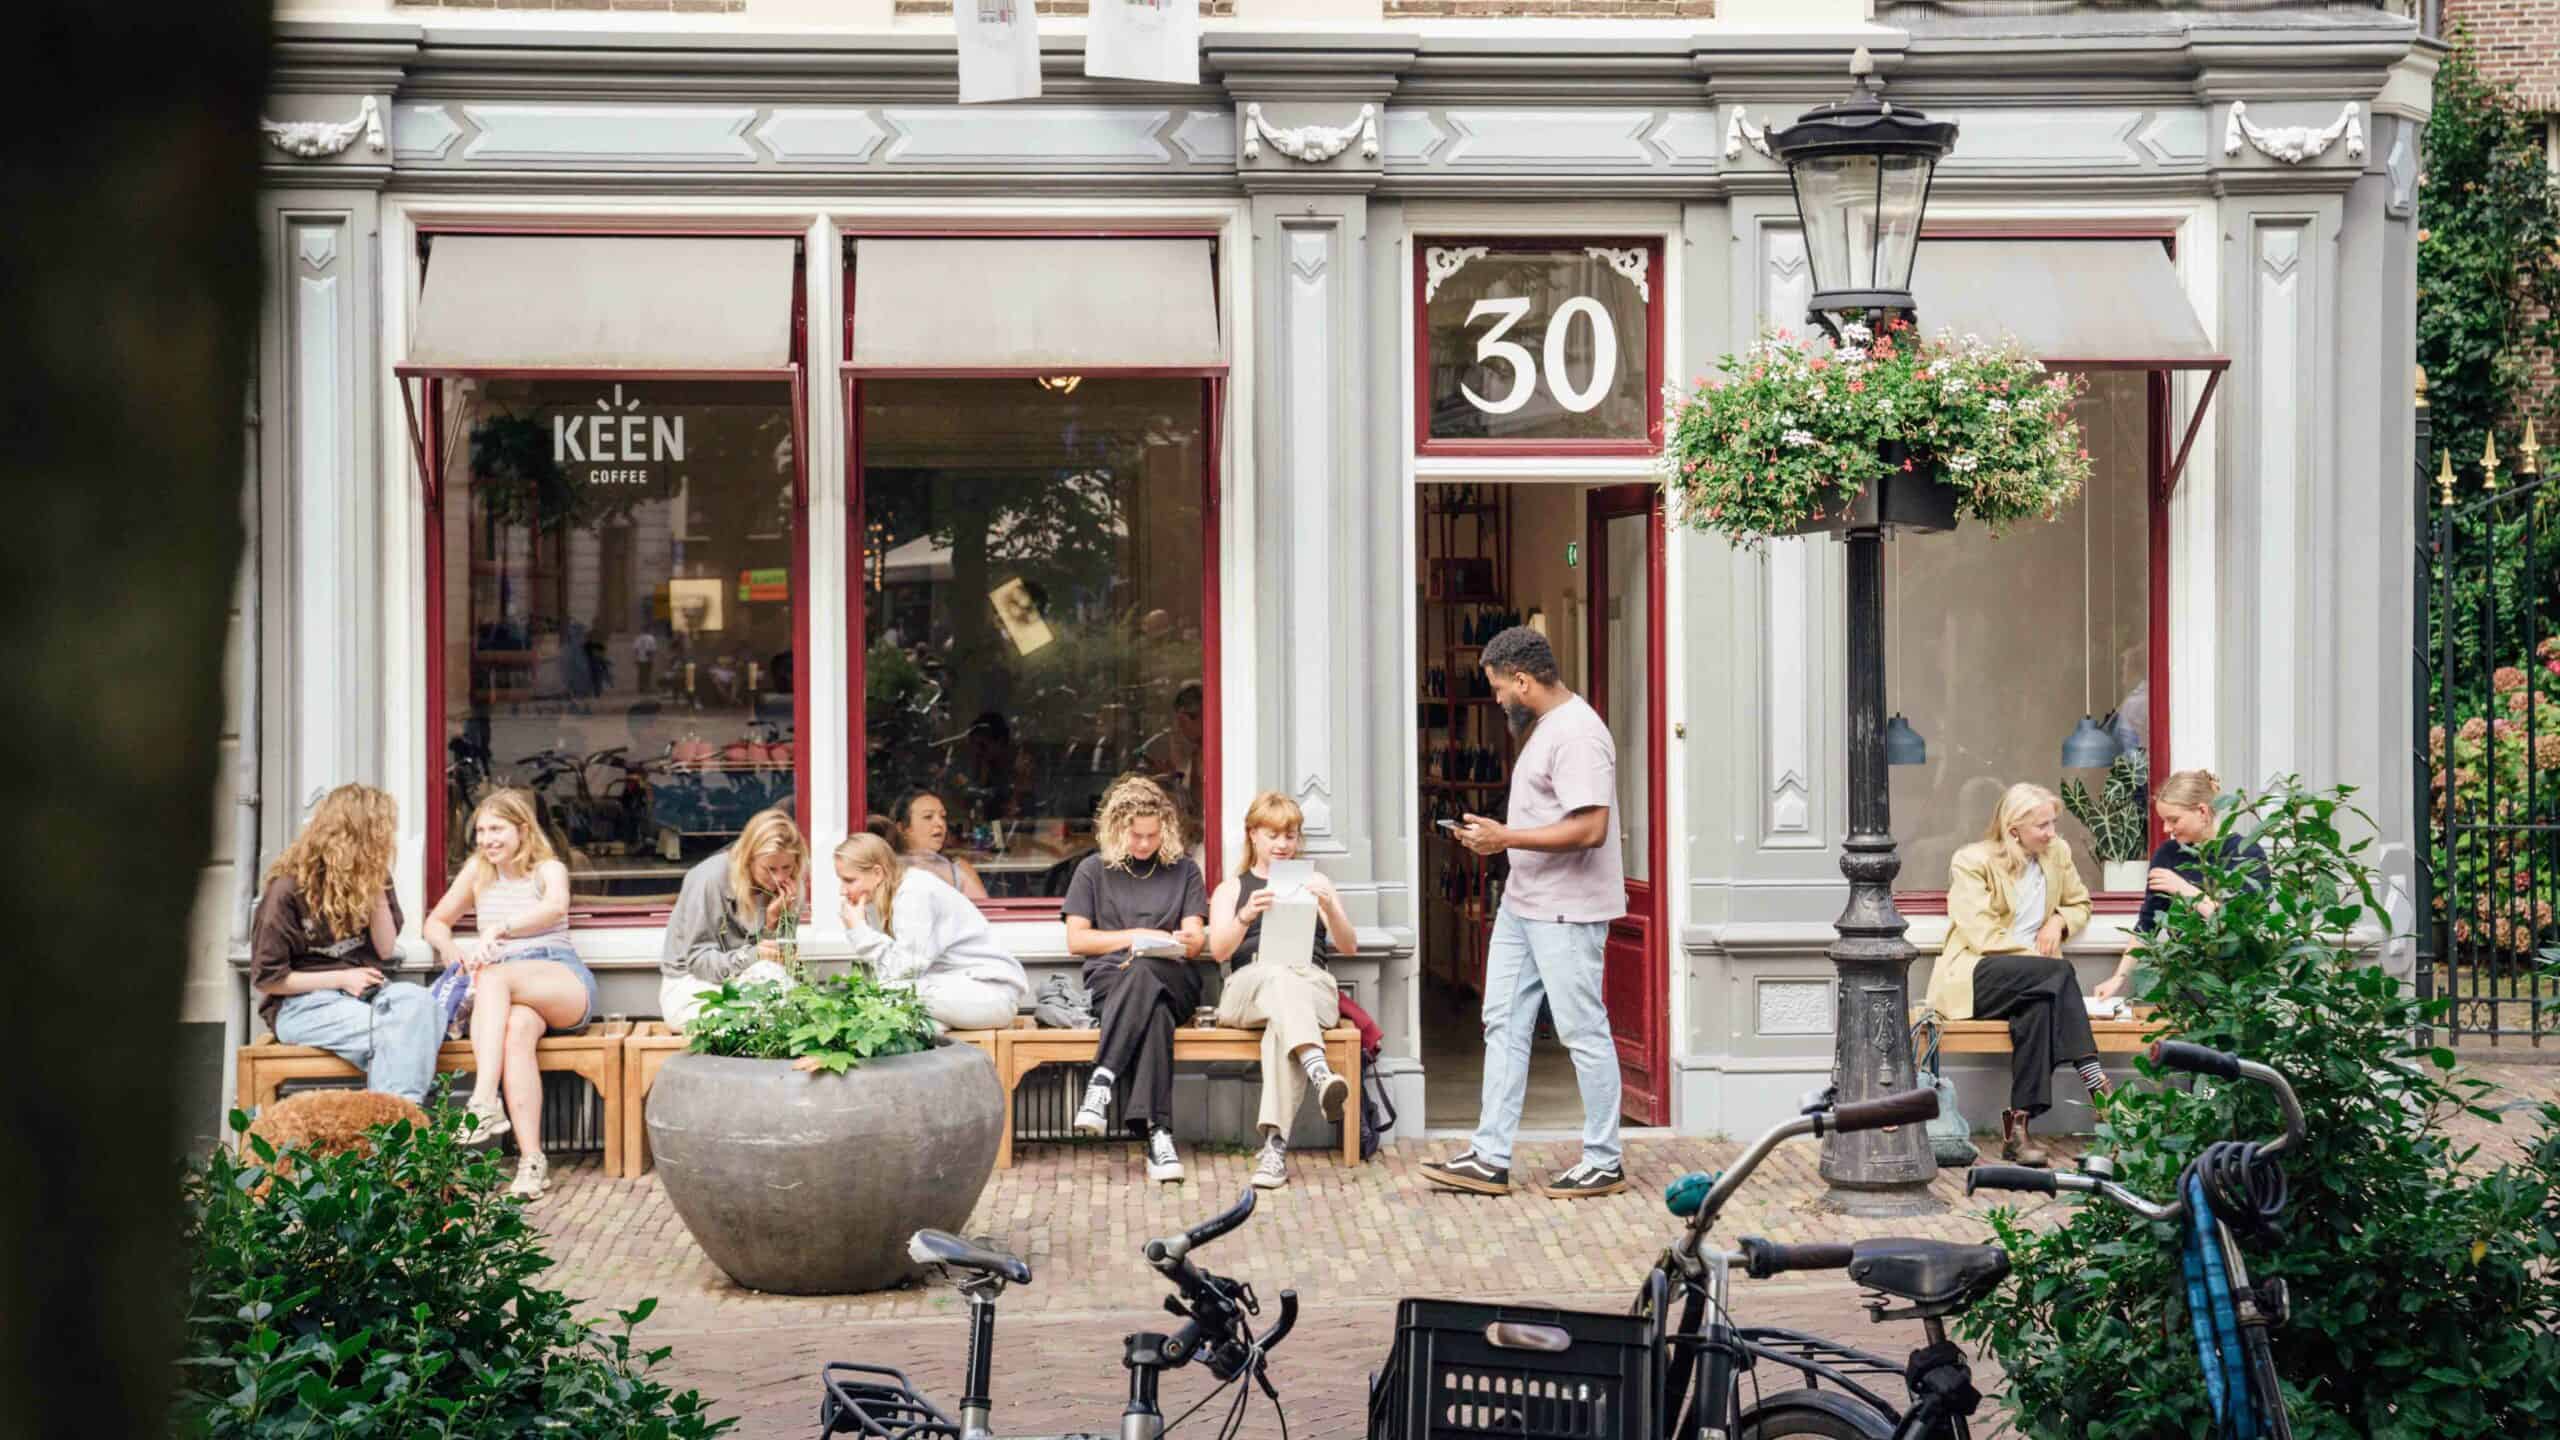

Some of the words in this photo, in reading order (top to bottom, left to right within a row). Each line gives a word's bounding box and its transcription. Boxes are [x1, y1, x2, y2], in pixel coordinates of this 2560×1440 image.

[1460, 296, 1617, 414] 30
[554, 415, 684, 462] KEEN
[590, 470, 648, 484] COFFEE
